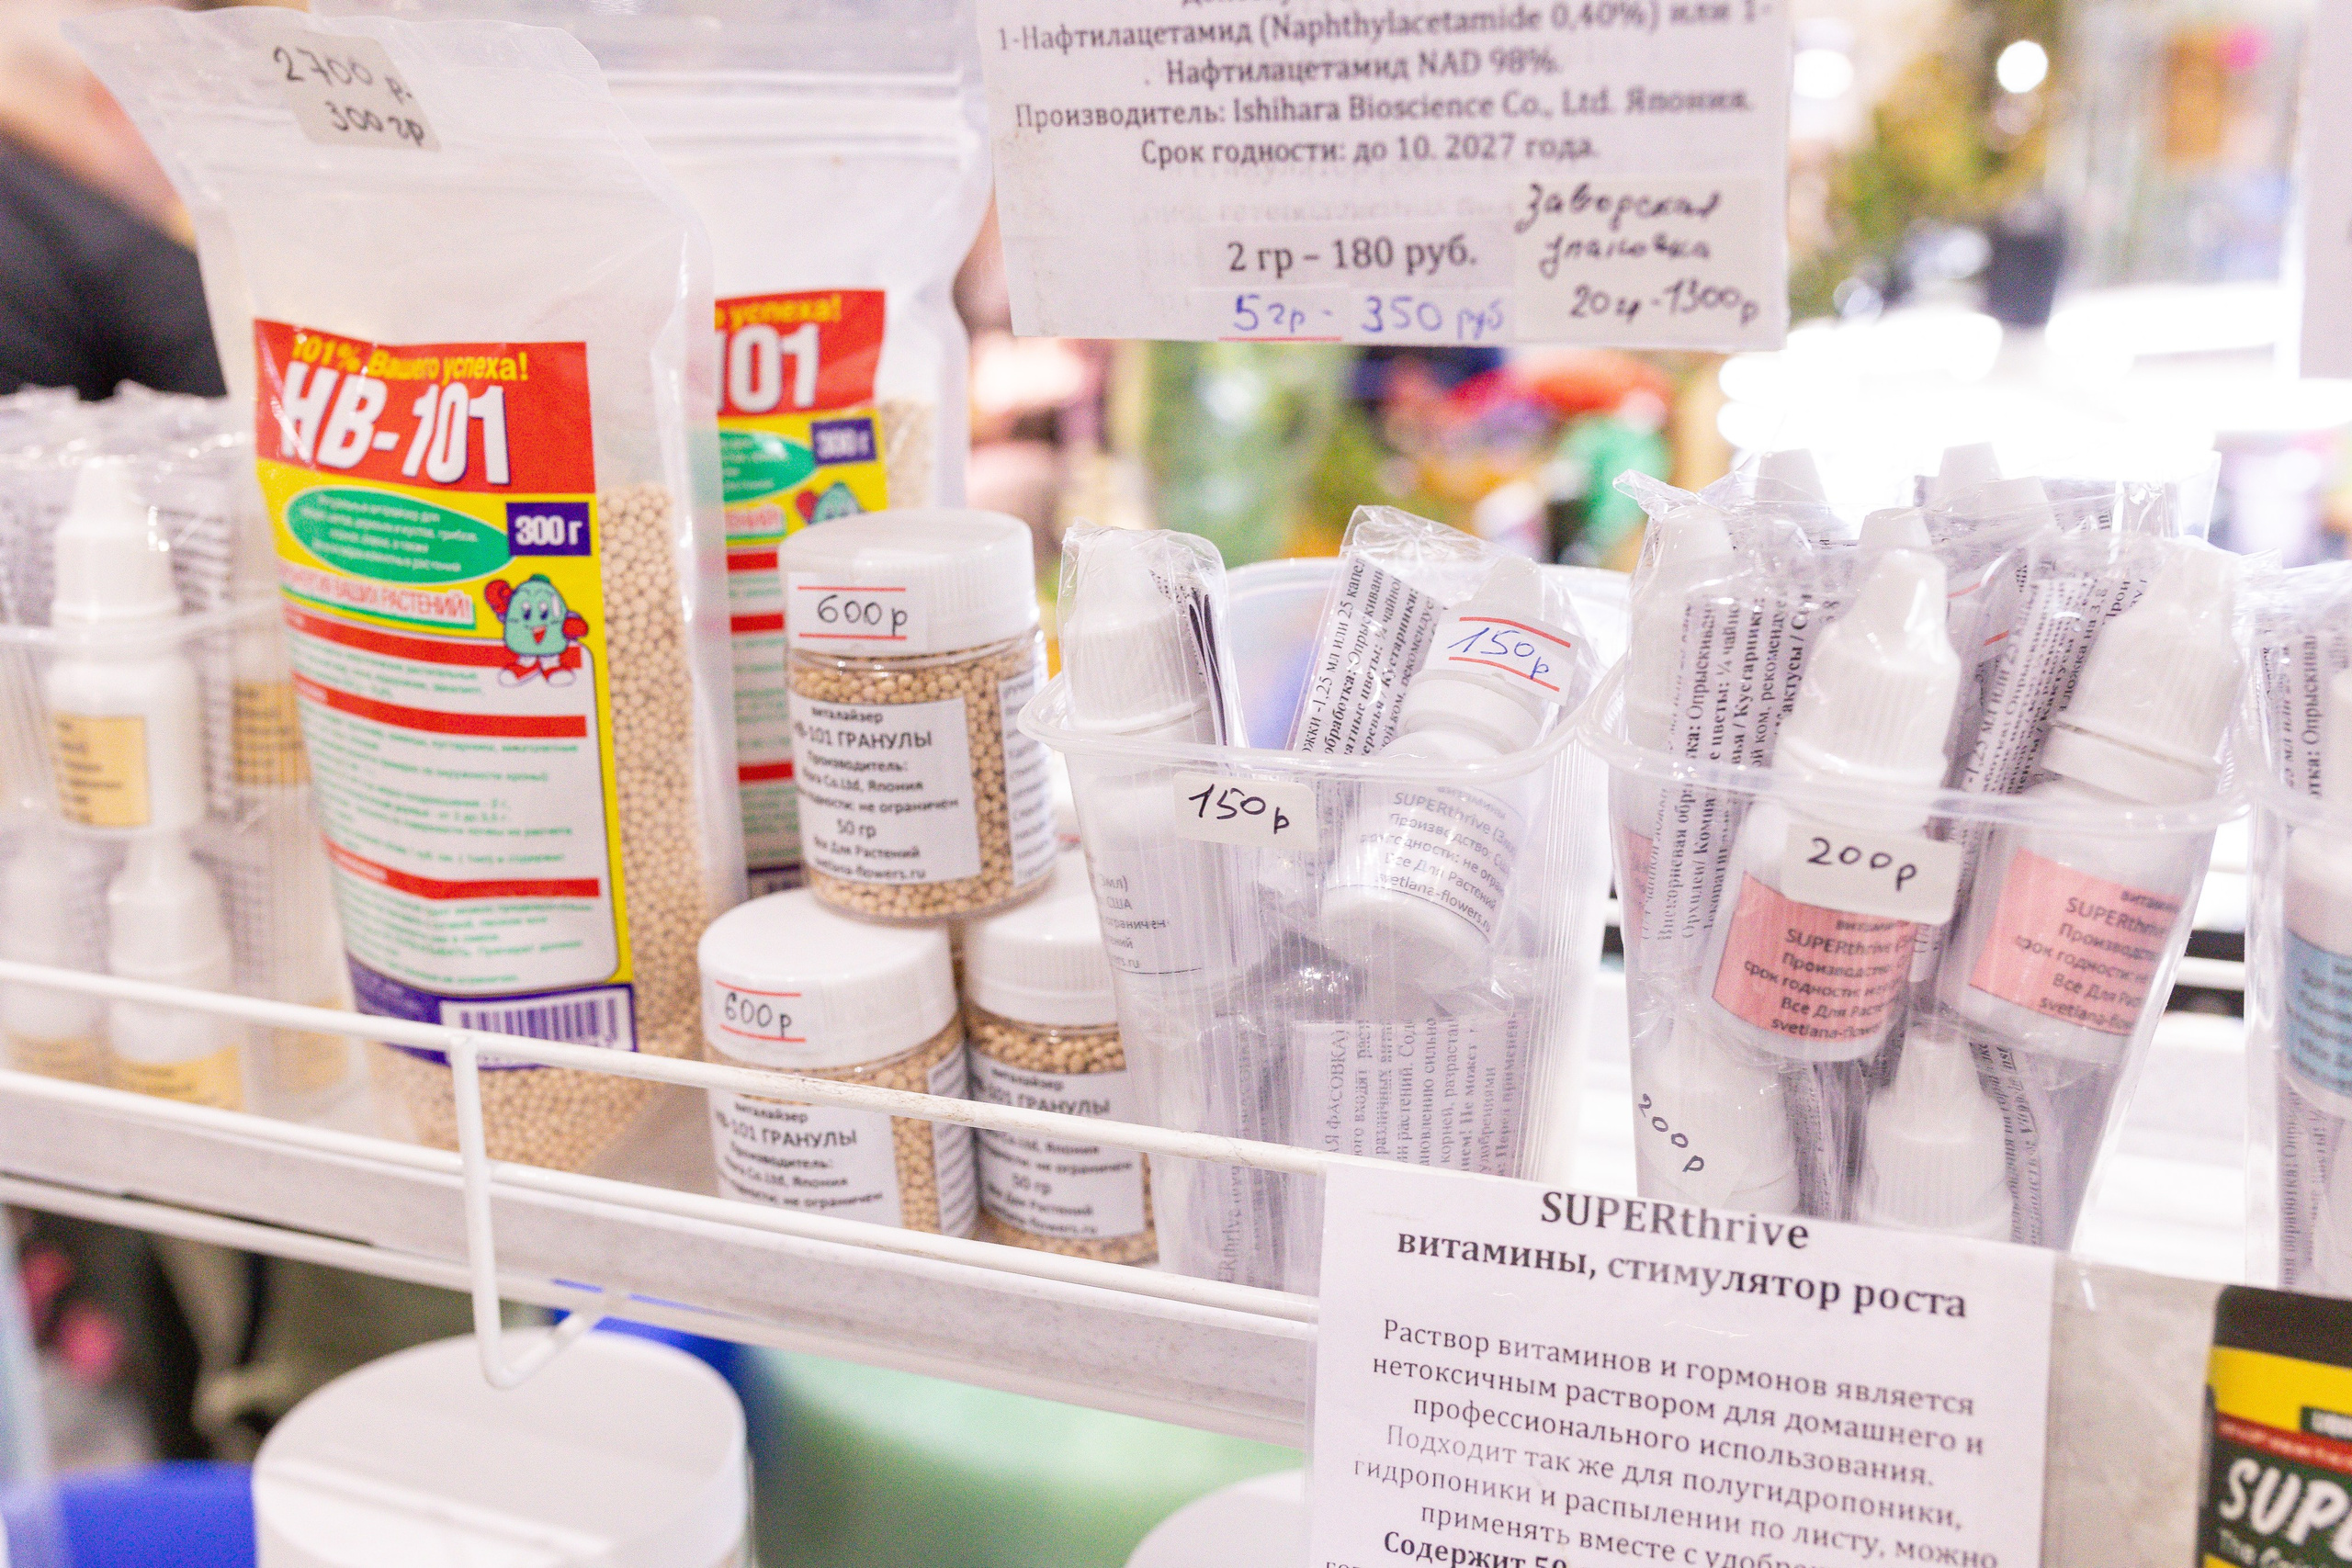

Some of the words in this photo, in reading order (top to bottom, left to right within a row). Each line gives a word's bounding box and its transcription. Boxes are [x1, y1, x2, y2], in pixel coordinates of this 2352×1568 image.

[998, 21, 1253, 54] 1-Нафтилацетамид
[273, 45, 373, 87] 2700
[1167, 52, 1409, 90] Нафтилацетамид
[1418, 50, 1482, 77] NAD
[1016, 102, 1226, 133] Производитель:
[1233, 96, 1340, 123] Ishihara
[1349, 92, 1494, 120] Bioscience
[1502, 90, 1554, 120] Co.,
[1141, 140, 1204, 170] Срок
[1213, 141, 1346, 167] годности:
[1353, 140, 1387, 165] до
[1396, 134, 1436, 163] 10.
[1445, 132, 1517, 161] 2027
[1525, 137, 1599, 162] года.
[1227, 241, 1248, 272] 2
[1257, 246, 1294, 279] гр
[1332, 237, 1395, 270] 180
[1405, 235, 1476, 276] руб.
[1362, 295, 1443, 333] 350
[515, 516, 563, 546] 300
[567, 521, 582, 545] г
[1338, 602, 1353, 618] 25
[1333, 621, 1349, 649] или
[1326, 654, 1340, 673] мл
[1781, 647, 1803, 713] актусы
[838, 730, 933, 750] ГРАНУЛЫ
[1362, 700, 1385, 756] еревья
[1188, 784, 1291, 835] 150р
[1393, 792, 1491, 835] SUPERthrive
[1805, 836, 1917, 891] 200р
[761, 1127, 856, 1148] ГРАНУЛЫ
[1541, 1191, 1810, 1250] SUPERthrive
[1396, 1233, 1597, 1279] витамины,
[1607, 1257, 1841, 1311] стимулятор
[1852, 1282, 1967, 1318] роста
[1384, 1318, 1489, 1358] Раствор
[1498, 1338, 1652, 1374] витаминов
[1660, 1358, 1677, 1378] и
[1686, 1360, 1827, 1396] гормонов
[1837, 1380, 1975, 1417] является
[1373, 1357, 1557, 1399] нетоксичным
[1565, 1383, 1715, 1420] раствором
[1724, 1403, 1776, 1428] для
[1783, 1411, 1957, 1452] домашнего
[1965, 1436, 1984, 1456] и
[1413, 1398, 1690, 1454] профессионального
[1700, 1436, 1934, 1488] использования.
[1386, 1424, 1517, 1465] Подходит
[1524, 1448, 1570, 1472] так
[1577, 1457, 1614, 1480] же
[1621, 1464, 1673, 1491] для
[1682, 1471, 1964, 1531] полугидропоники,
[1353, 1458, 1532, 1505] гидропоники
[1540, 1487, 1556, 1506] и
[1565, 1490, 1741, 1535] распылении
[1750, 1518, 1784, 1540] по
[1792, 1522, 1887, 1560] листу,
[1894, 1539, 1998, 1568] можно
[1420, 1506, 1572, 1549] применять
[1579, 1529, 1676, 1562] вместе
[1684, 1546, 1698, 1563] с
